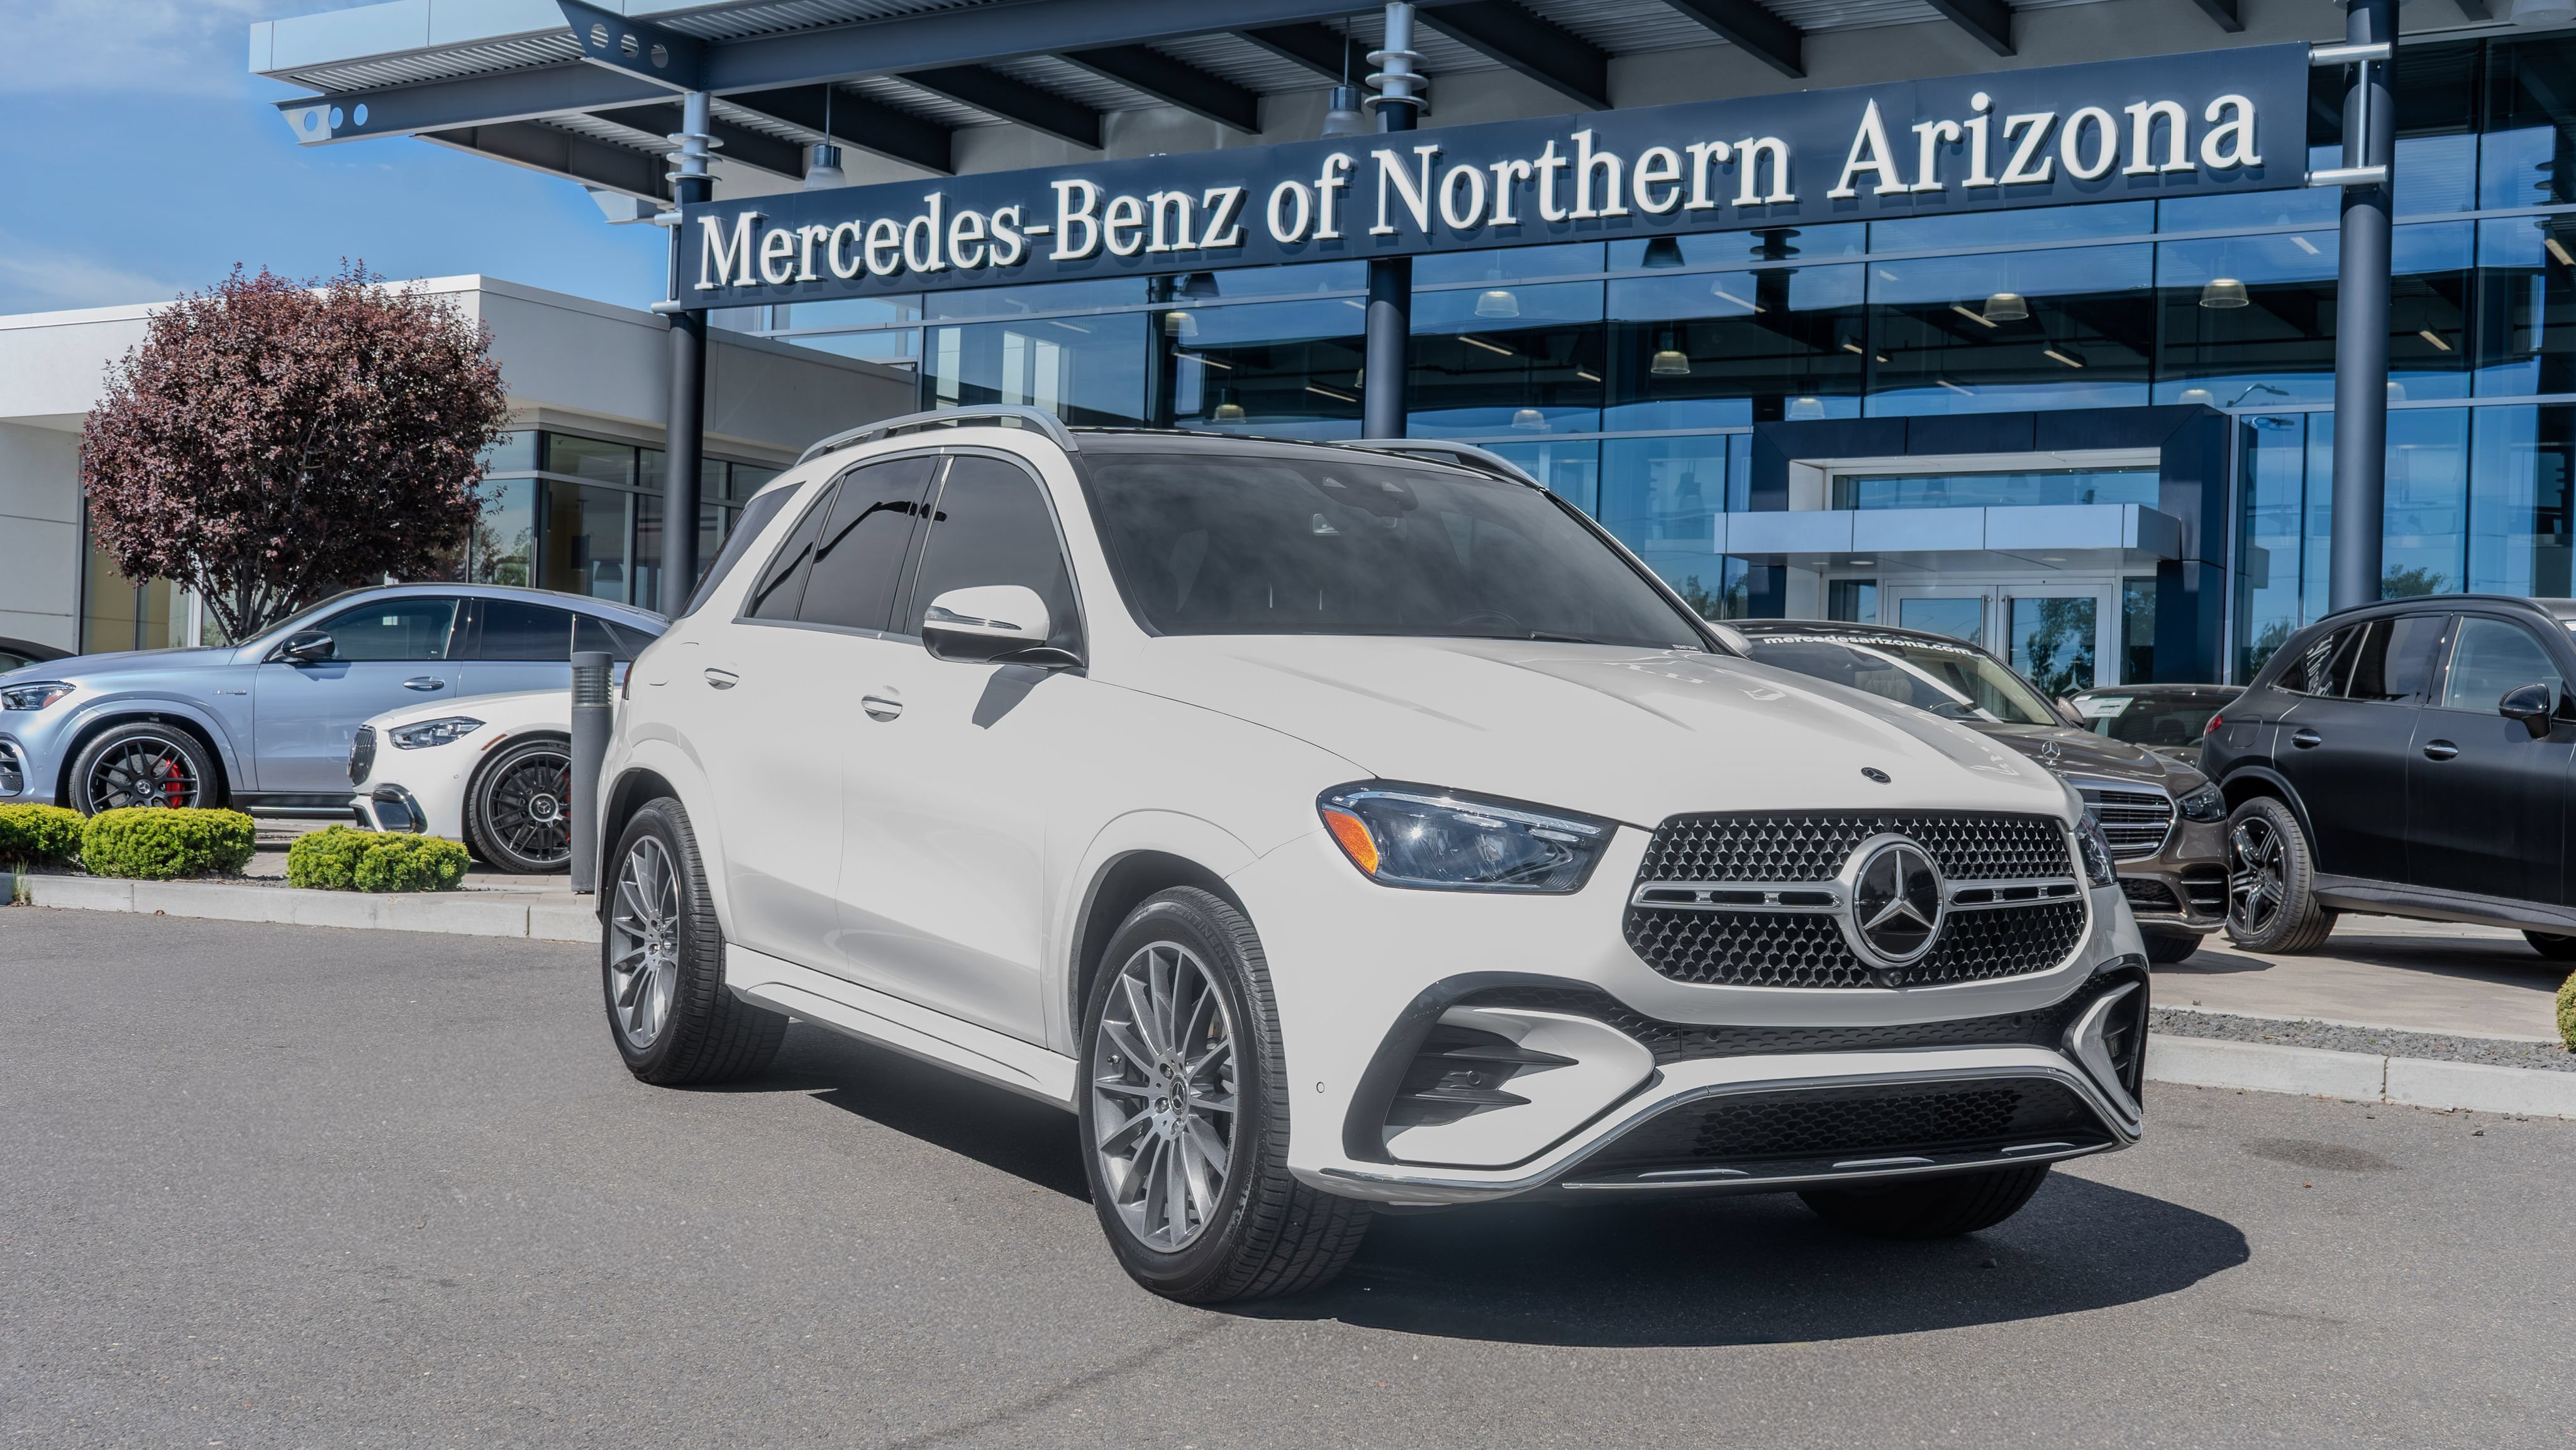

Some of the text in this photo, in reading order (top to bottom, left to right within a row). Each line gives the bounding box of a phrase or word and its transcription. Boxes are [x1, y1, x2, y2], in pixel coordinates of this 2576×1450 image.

[694, 92, 2262, 291] Mercedes-Benz of Northern Arizona
[1763, 634, 1973, 655] mercedesarizona.com
[1167, 905, 1240, 995] CONTINENTAL
